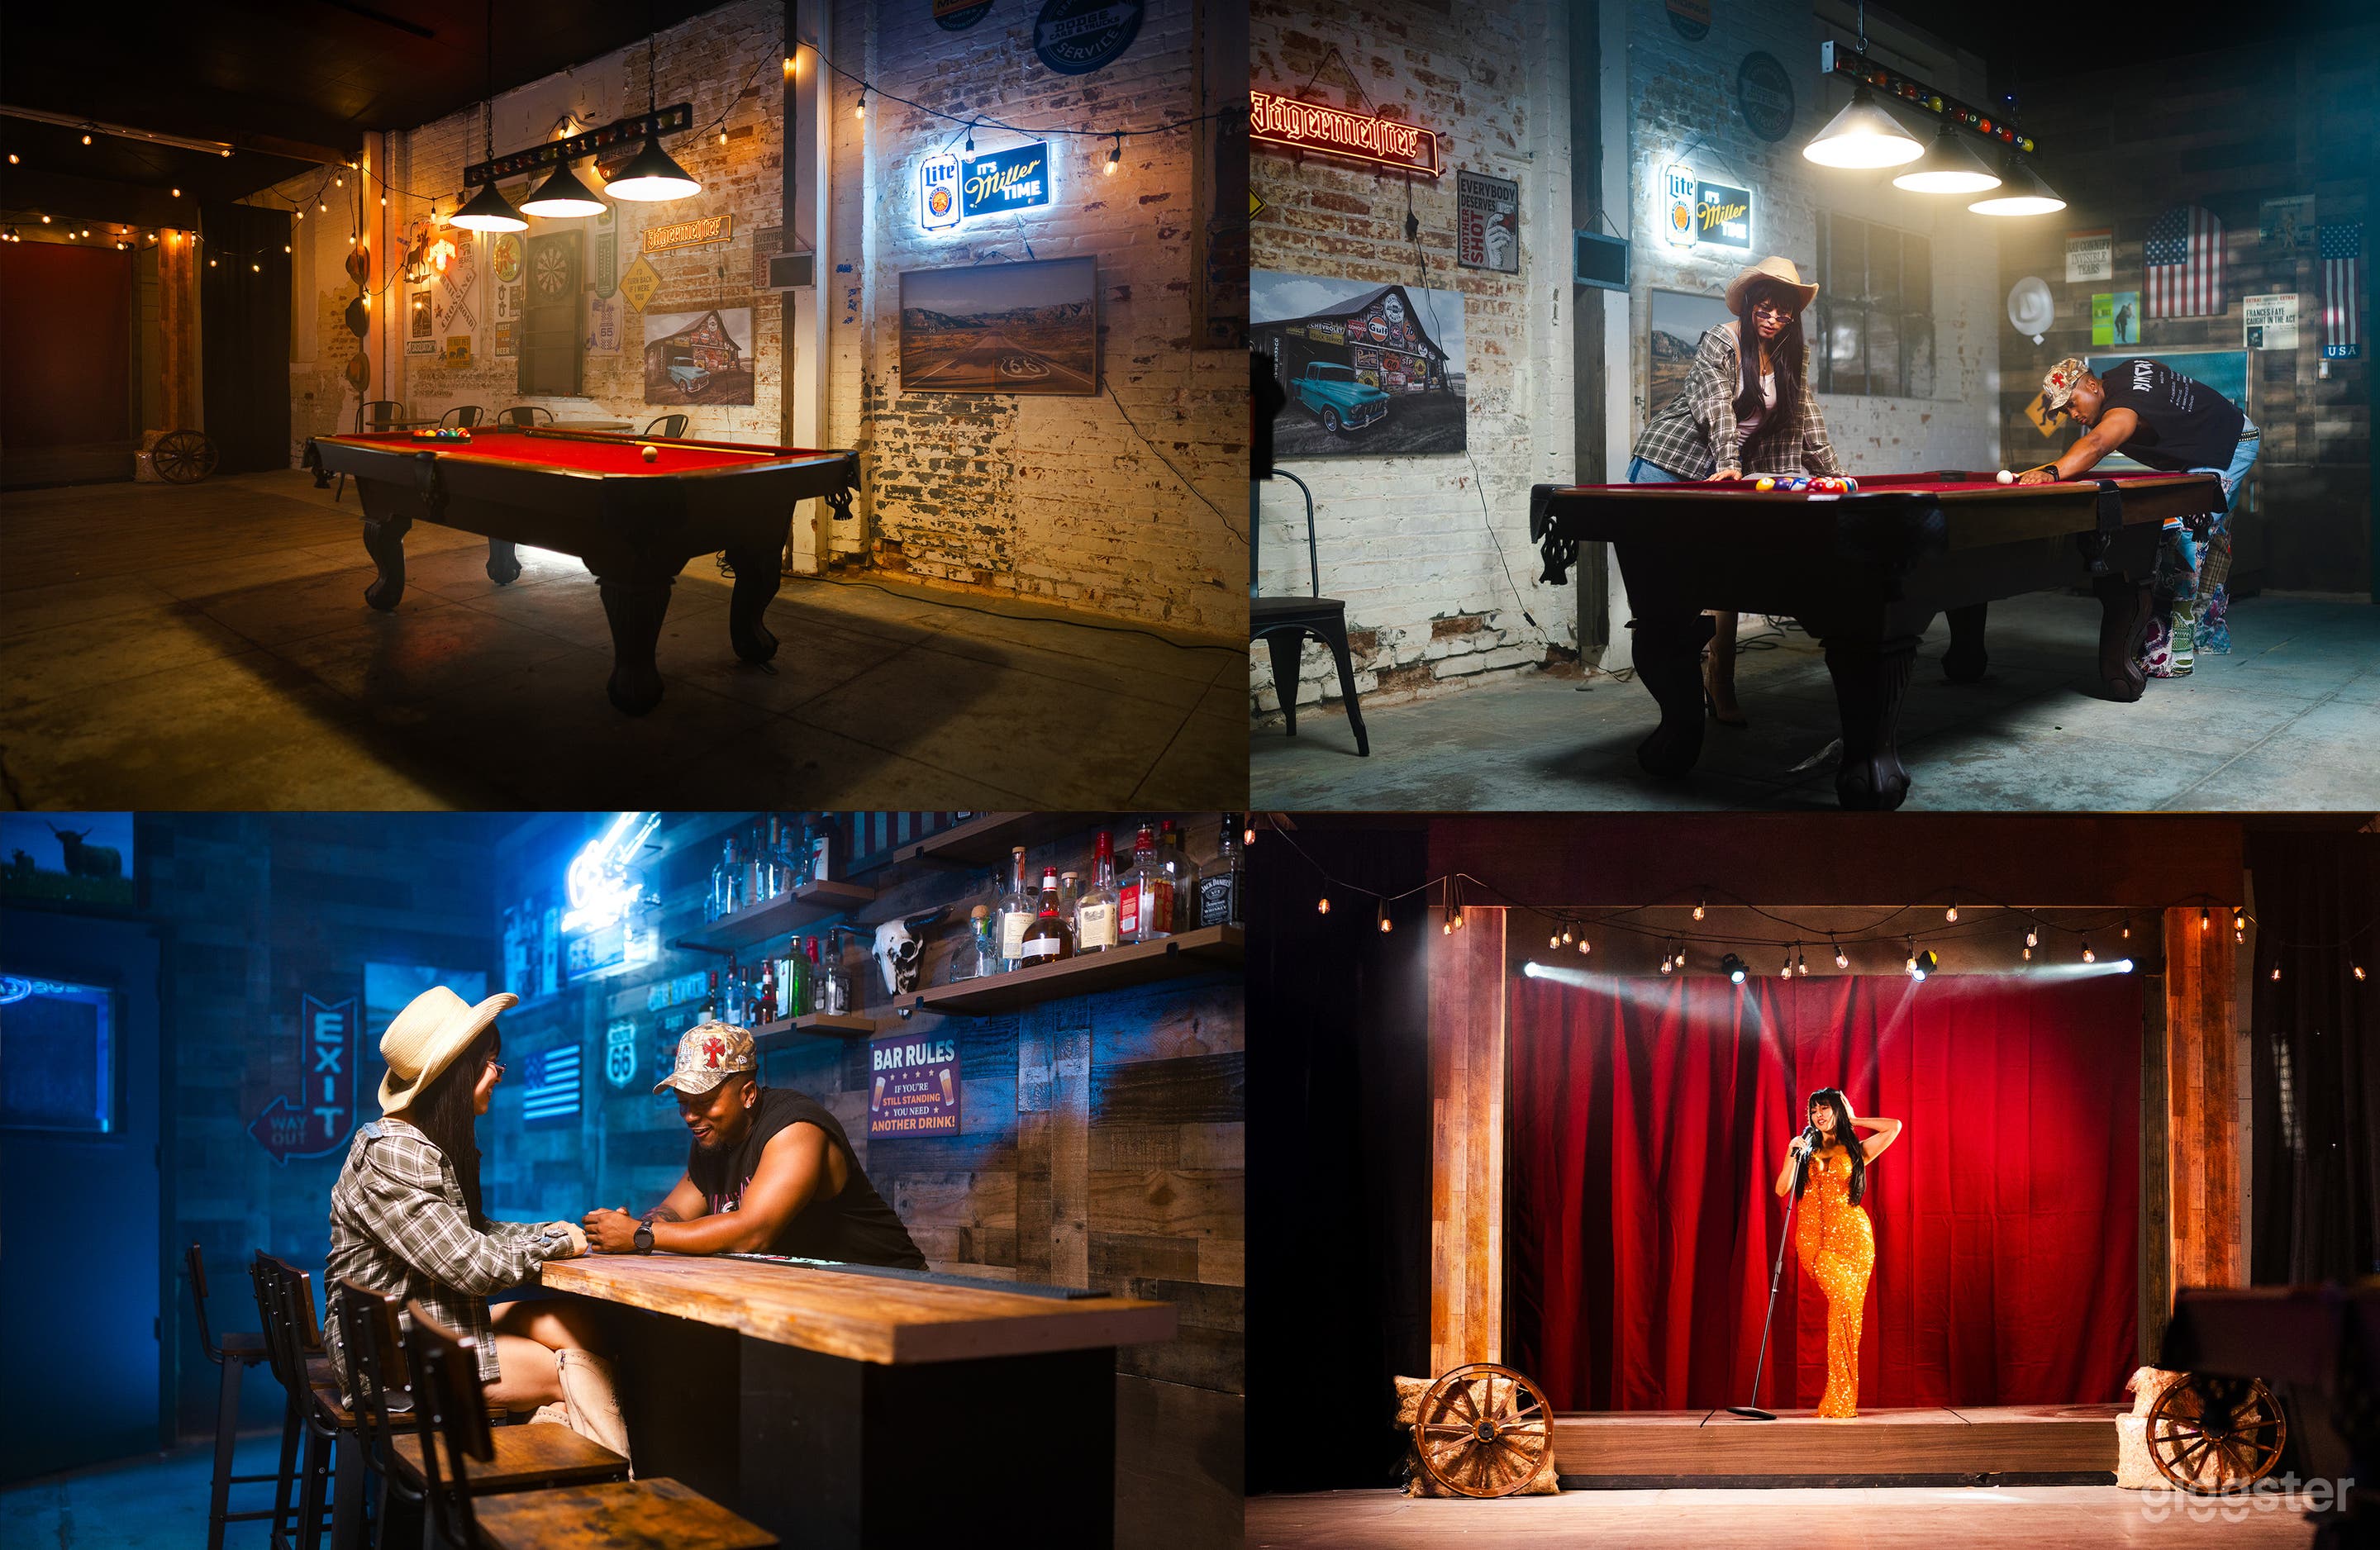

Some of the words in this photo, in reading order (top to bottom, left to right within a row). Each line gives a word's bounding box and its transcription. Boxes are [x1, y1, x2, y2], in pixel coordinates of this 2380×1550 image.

[1050, 28, 1073, 40] CARS
[1085, 16, 1120, 31] TRUCKS
[1054, 10, 1109, 33] DODGE
[1057, 29, 1119, 59] SERVICE
[926, 164, 955, 187] Lite
[977, 161, 997, 175] IT'S
[964, 159, 1041, 204] Miller
[1669, 174, 1693, 198] Lite
[1002, 179, 1042, 201] TIME
[1460, 178, 1516, 202] EVERYBODY
[1460, 194, 1496, 212] DESERVES
[1697, 202, 1747, 231] Miller
[1462, 208, 1470, 261] ANOTHER
[1470, 211, 1484, 264] SHOT
[2071, 251, 2107, 265] INVISIBLE
[2078, 264, 2101, 275] TEARS
[640, 275, 653, 283] BACK
[2246, 307, 2271, 317] FRANCES
[2271, 307, 2284, 316] FAYE
[2246, 316, 2266, 325] CAUGHT
[2267, 316, 2273, 324] IN
[2274, 316, 2284, 324] THE
[2285, 315, 2296, 323] ACT
[1369, 323, 1388, 335] Gulf
[1406, 326, 1414, 335] 76
[2328, 345, 2357, 356] USA
[1009, 359, 1041, 374] 66
[1388, 359, 1397, 369] 66
[1201, 880, 1213, 893] JACK
[612, 1044, 630, 1078] 66
[873, 1047, 902, 1071] BAR
[906, 1039, 955, 1067] RULES
[313, 1012, 344, 1139] EXIT
[894, 1085, 902, 1093] IF
[902, 1082, 929, 1093] YOU'RE
[883, 1096, 902, 1106] STILL
[902, 1092, 940, 1105] STANDING
[893, 1107, 909, 1117] YOU
[909, 1105, 930, 1115] NEED
[270, 1116, 307, 1130] WAY
[872, 1118, 916, 1132] ANOTHER
[918, 1115, 955, 1129] DRINK!
[272, 1133, 307, 1145] OUT
